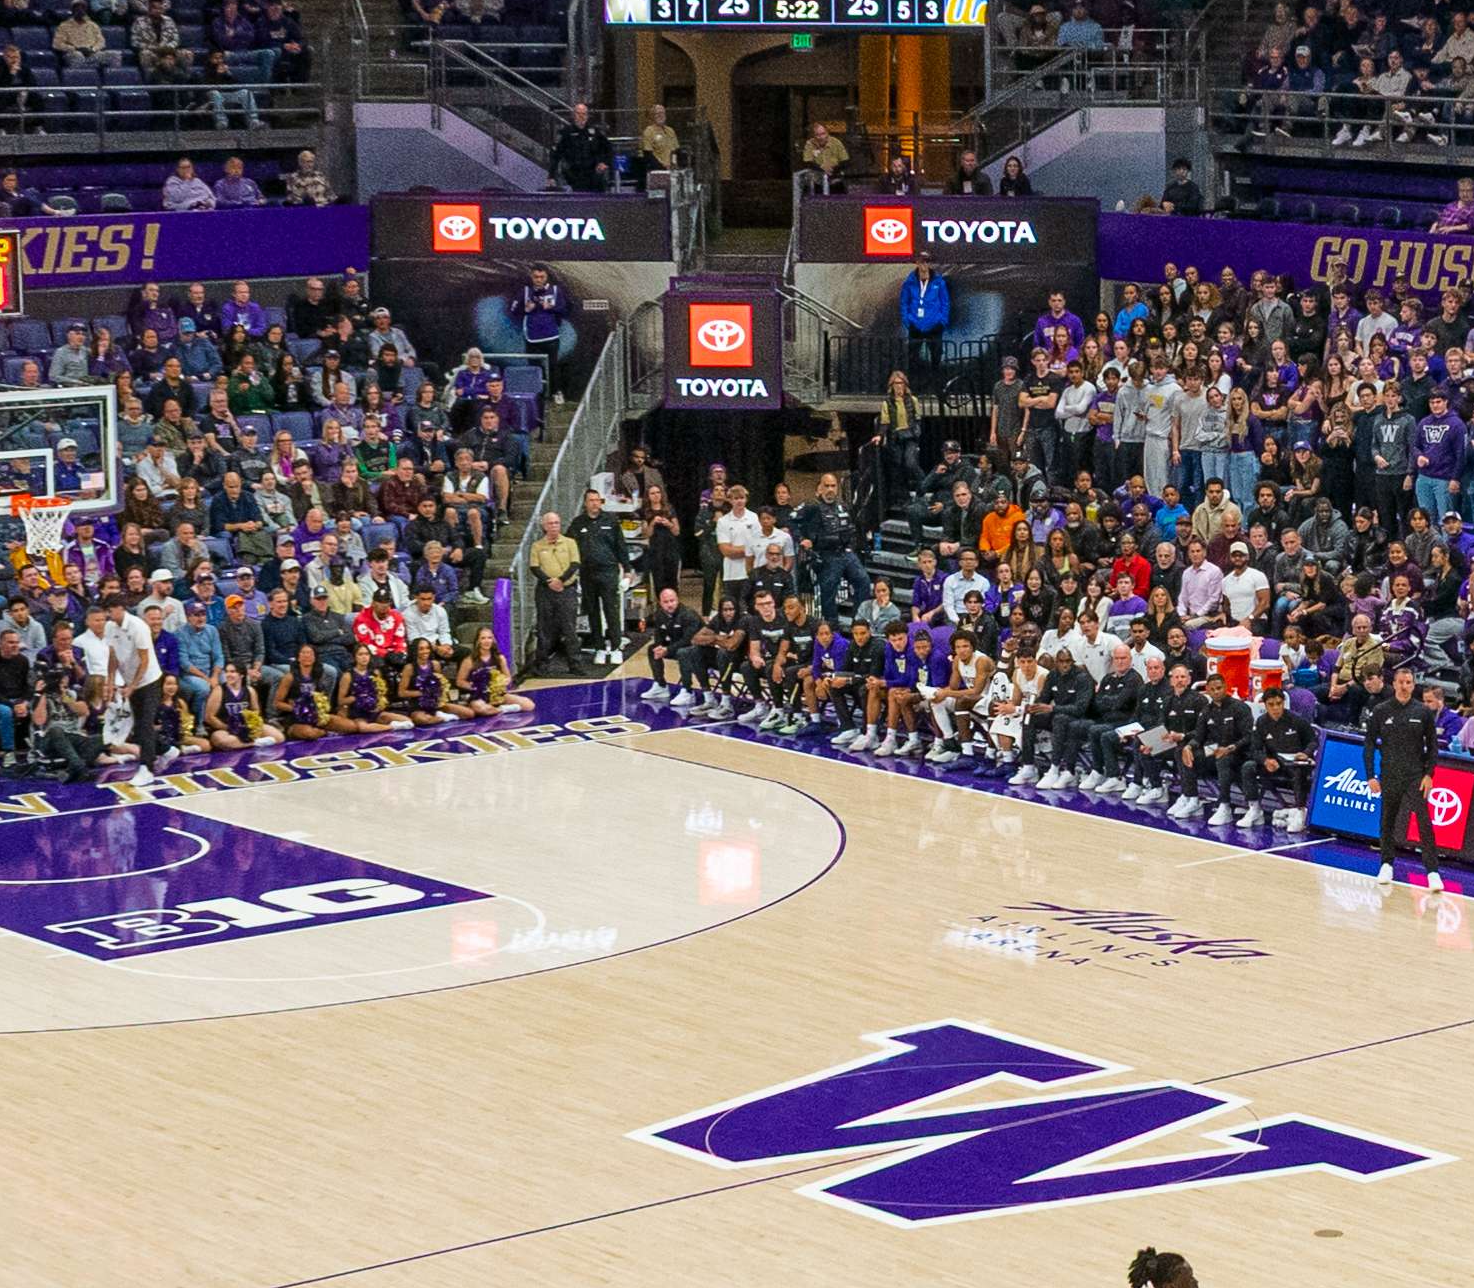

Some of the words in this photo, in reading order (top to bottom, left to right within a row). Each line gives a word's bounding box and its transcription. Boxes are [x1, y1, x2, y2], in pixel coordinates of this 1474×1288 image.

[776, 0, 820, 18] 5:22
[489, 217, 605, 240] TOYOTA
[922, 221, 1037, 243] TOYOTA
[1310, 237, 1367, 283] GO
[677, 379, 768, 397] TOYOTA
[1380, 425, 1399, 442] W
[97, 714, 652, 804] HUSKIES
[1324, 795, 1375, 812] AIRLINES
[1003, 901, 1273, 960] Alaska
[626, 1018, 1460, 1228] W
